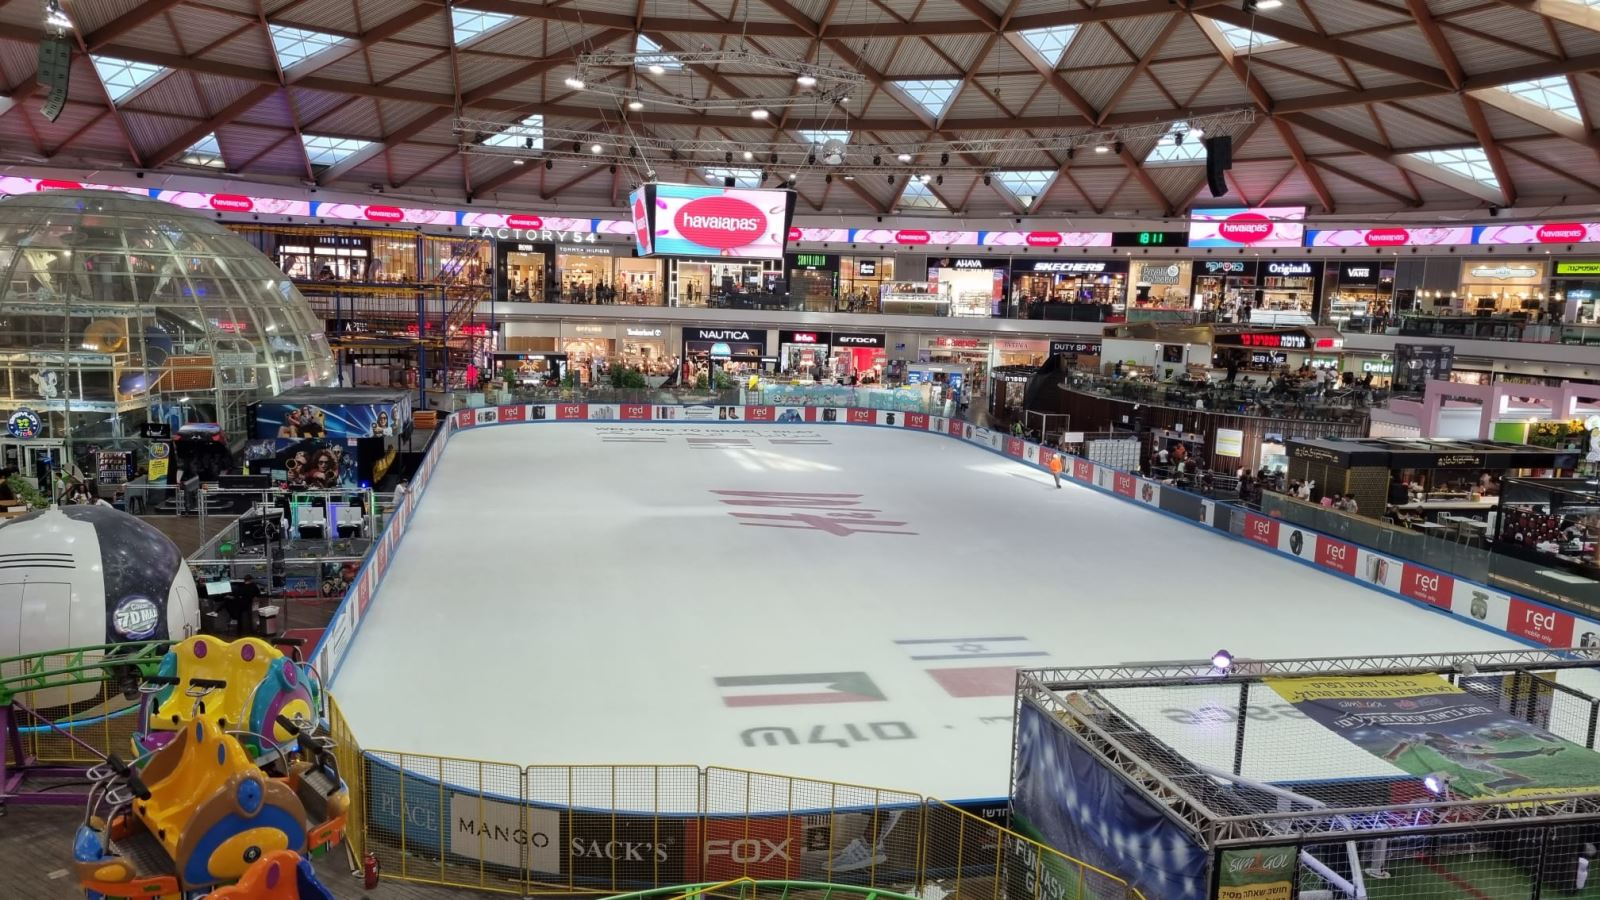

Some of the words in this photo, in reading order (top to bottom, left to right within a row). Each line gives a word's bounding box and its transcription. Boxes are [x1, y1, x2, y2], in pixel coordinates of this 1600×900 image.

[683, 212, 758, 231] havaianas
[1223, 222, 1269, 233] havaianas
[469, 226, 569, 242] FACTORY
[573, 231, 596, 244] 54
[955, 259, 982, 268] AHAVA
[1033, 262, 1106, 272] SKECHERS
[1269, 263, 1311, 275] Original's
[1347, 268, 1370, 278] VANS
[700, 329, 749, 341] NAUTICA
[1054, 343, 1076, 351] DUTY
[1281, 335, 1306, 348] ארומה
[1363, 363, 1389, 373] Delta
[504, 407, 519, 417] red
[564, 404, 580, 415] red
[628, 405, 643, 415] red
[752, 407, 767, 417] red
[854, 410, 869, 419] red
[911, 414, 923, 425] red
[1079, 462, 1088, 474] red
[1119, 476, 1130, 489] red
[1253, 520, 1270, 535] red
[1326, 543, 1346, 560] red
[1415, 572, 1439, 592] red
[117, 611, 140, 628] 7D
[1525, 608, 1556, 631] red
[1524, 628, 1541, 640] mobile
[1541, 634, 1553, 643] only
[740, 721, 918, 748] שלום
[381, 792, 438, 831] PLACE
[459, 817, 549, 848] MANGO
[703, 838, 794, 864] FOX
[1262, 854, 1289, 869] GOL
